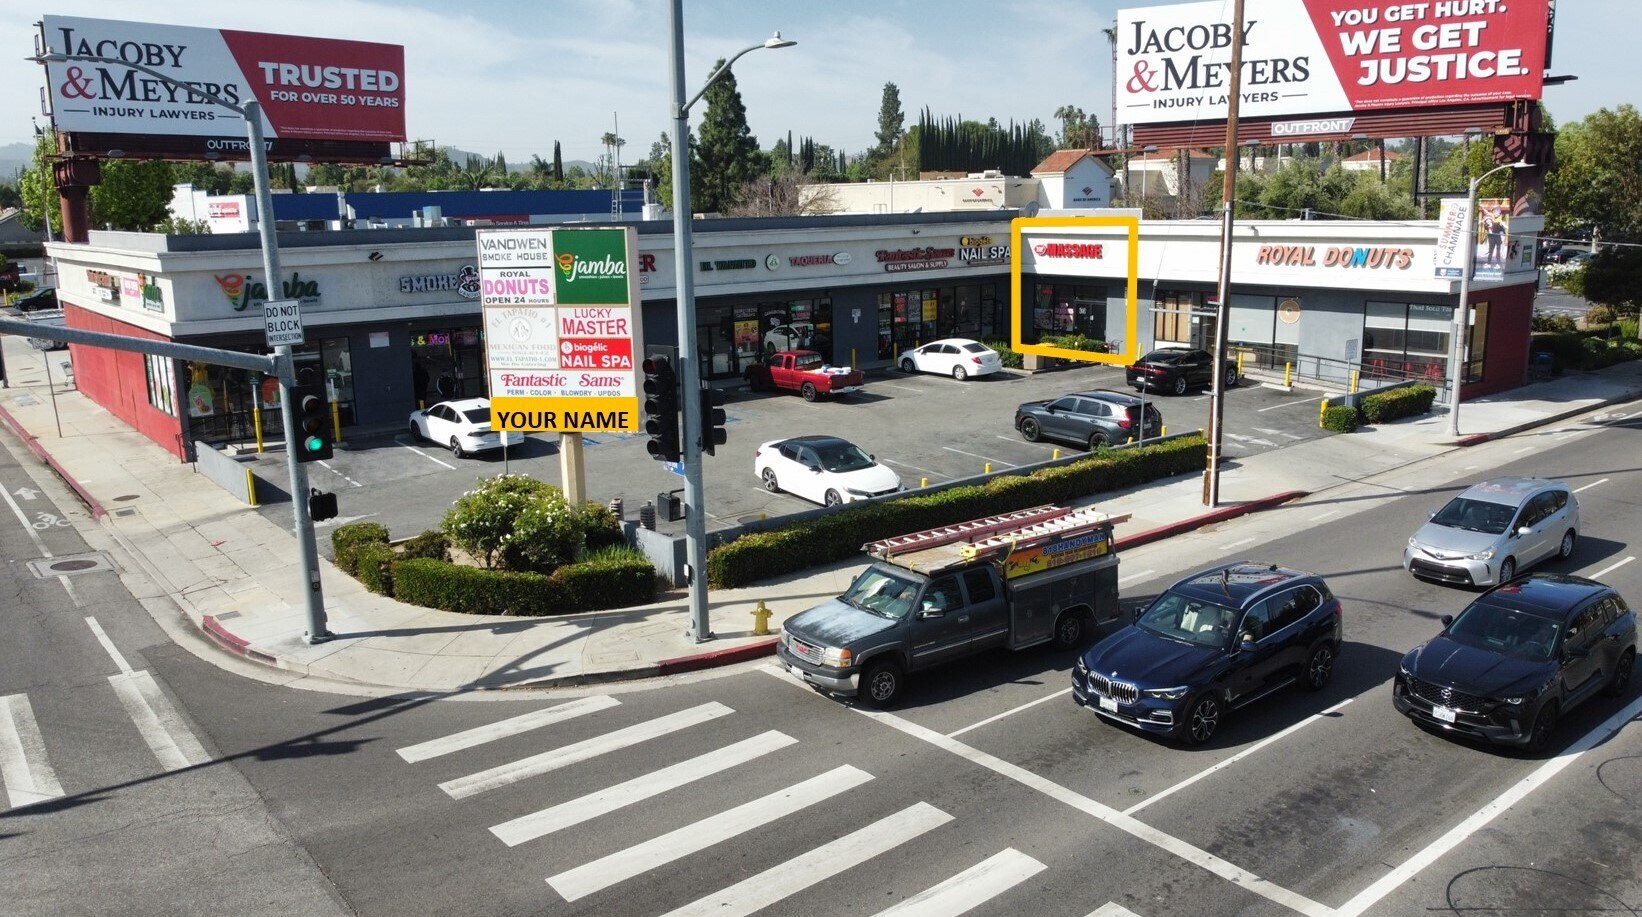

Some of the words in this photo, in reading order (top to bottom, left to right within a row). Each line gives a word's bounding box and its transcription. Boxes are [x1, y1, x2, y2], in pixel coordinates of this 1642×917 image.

[1330, 8, 1378, 27] YOU
[1384, 1, 1430, 22] GET
[1435, 0, 1507, 18] HURT.
[1128, 20, 1258, 56] JACOBY
[1339, 28, 1402, 56] WE
[1412, 20, 1487, 51] GET
[58, 27, 187, 68] JACOBY
[1356, 48, 1529, 86] JUSTICE.
[258, 61, 400, 92] TRUSTED
[270, 90, 298, 102] FOR
[301, 92, 338, 104] OVER
[340, 95, 356, 105] 50
[358, 96, 399, 108] YEARS
[1153, 96, 1204, 109] INJURY
[93, 106, 144, 118] INJURY
[150, 109, 216, 120] LAWYERS
[1440, 211, 1457, 249] SUMMER
[1443, 206, 1467, 265] CHAMINADE
[481, 238, 547, 250] VANOWEN
[1047, 243, 1103, 259] MASSAGE
[482, 253, 512, 261] SMOKE
[517, 252, 548, 260] HOUSE
[960, 248, 987, 260] NAIL
[990, 246, 1011, 258] SPA
[1256, 245, 1315, 266] ROYAL
[1322, 247, 1415, 270] DONUTS
[566, 254, 626, 282] jamba
[400, 274, 458, 292] SMOKE
[484, 278, 549, 295] DONUTS
[266, 307, 278, 317] DO
[280, 306, 298, 316] NOT
[574, 308, 612, 318] LUCKY
[268, 320, 300, 332] BLOCK
[562, 318, 628, 335] MASTER
[268, 334, 301, 342] INTERSECTION
[561, 355, 597, 367] NAIL
[601, 355, 631, 367] SPA
[500, 374, 568, 387] Fantastic
